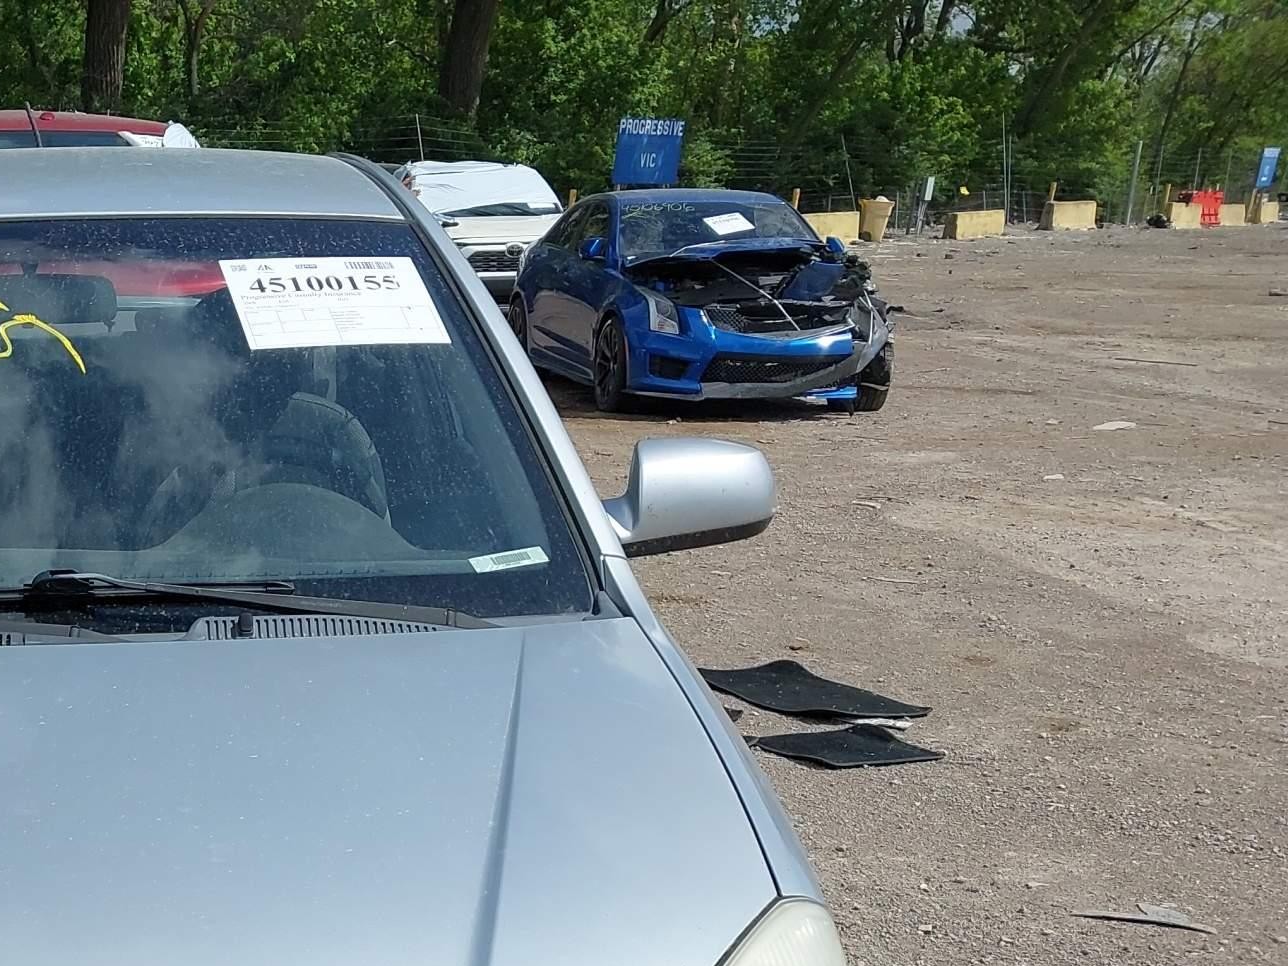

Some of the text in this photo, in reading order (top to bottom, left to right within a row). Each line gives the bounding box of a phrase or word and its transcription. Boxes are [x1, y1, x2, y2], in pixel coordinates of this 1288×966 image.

[619, 119, 685, 136] PROGRESSIVE
[640, 153, 657, 168] VIC
[249, 274, 401, 293] 45100155
